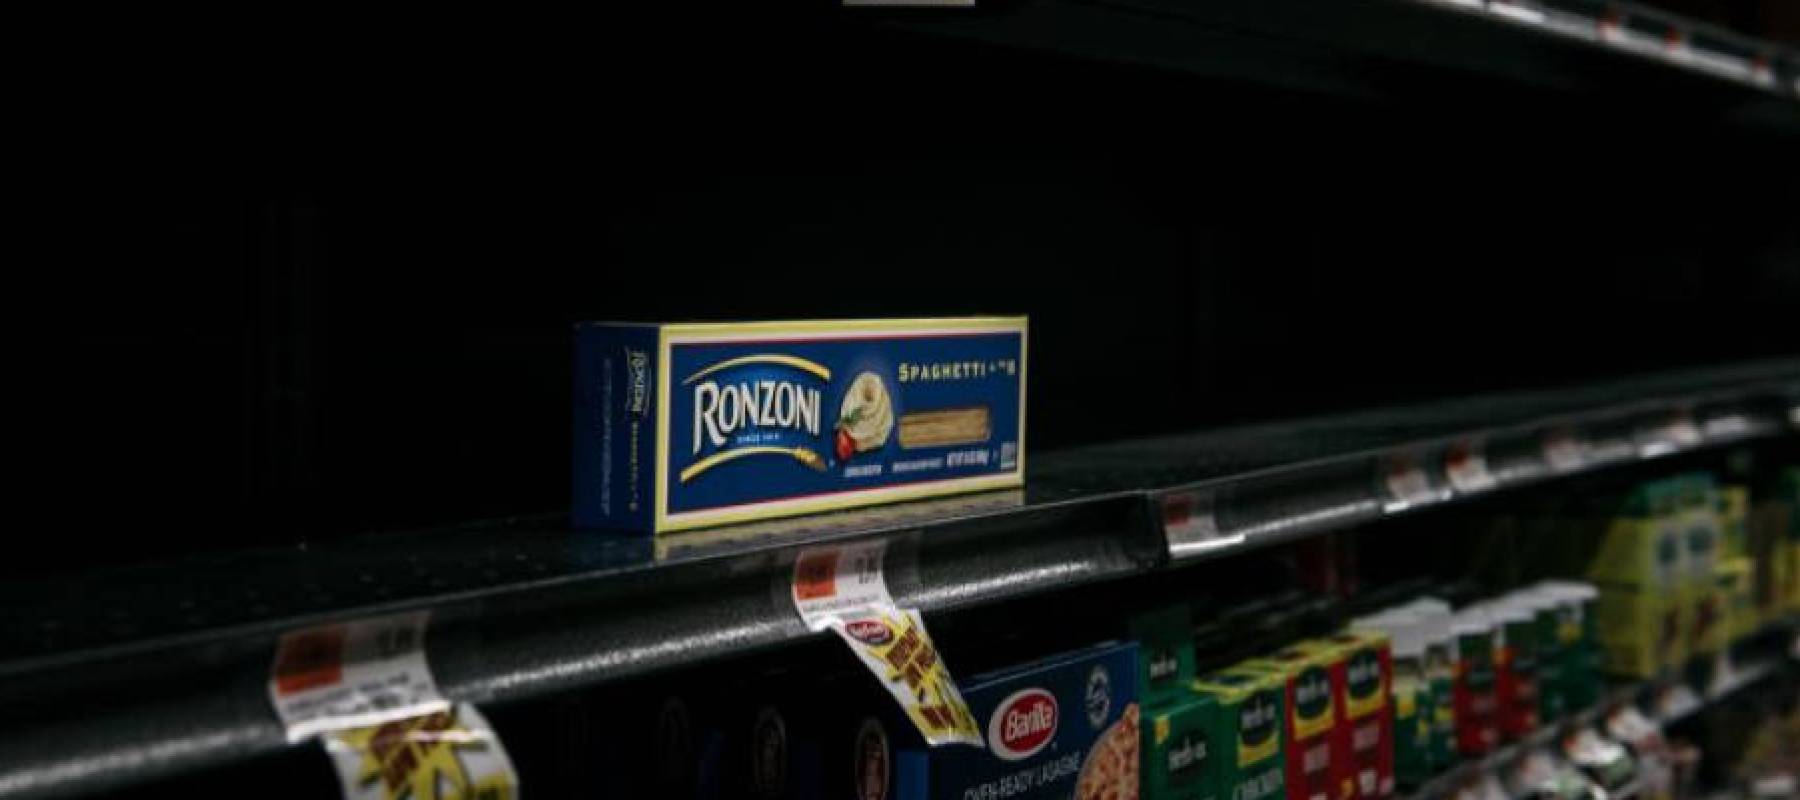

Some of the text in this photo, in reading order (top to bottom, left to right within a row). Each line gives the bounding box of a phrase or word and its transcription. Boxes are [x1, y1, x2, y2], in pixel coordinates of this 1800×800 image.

[898, 361, 986, 382] SPAGHETTI
[692, 380, 822, 455] RONZONI
[1004, 699, 1054, 742] Barilla
